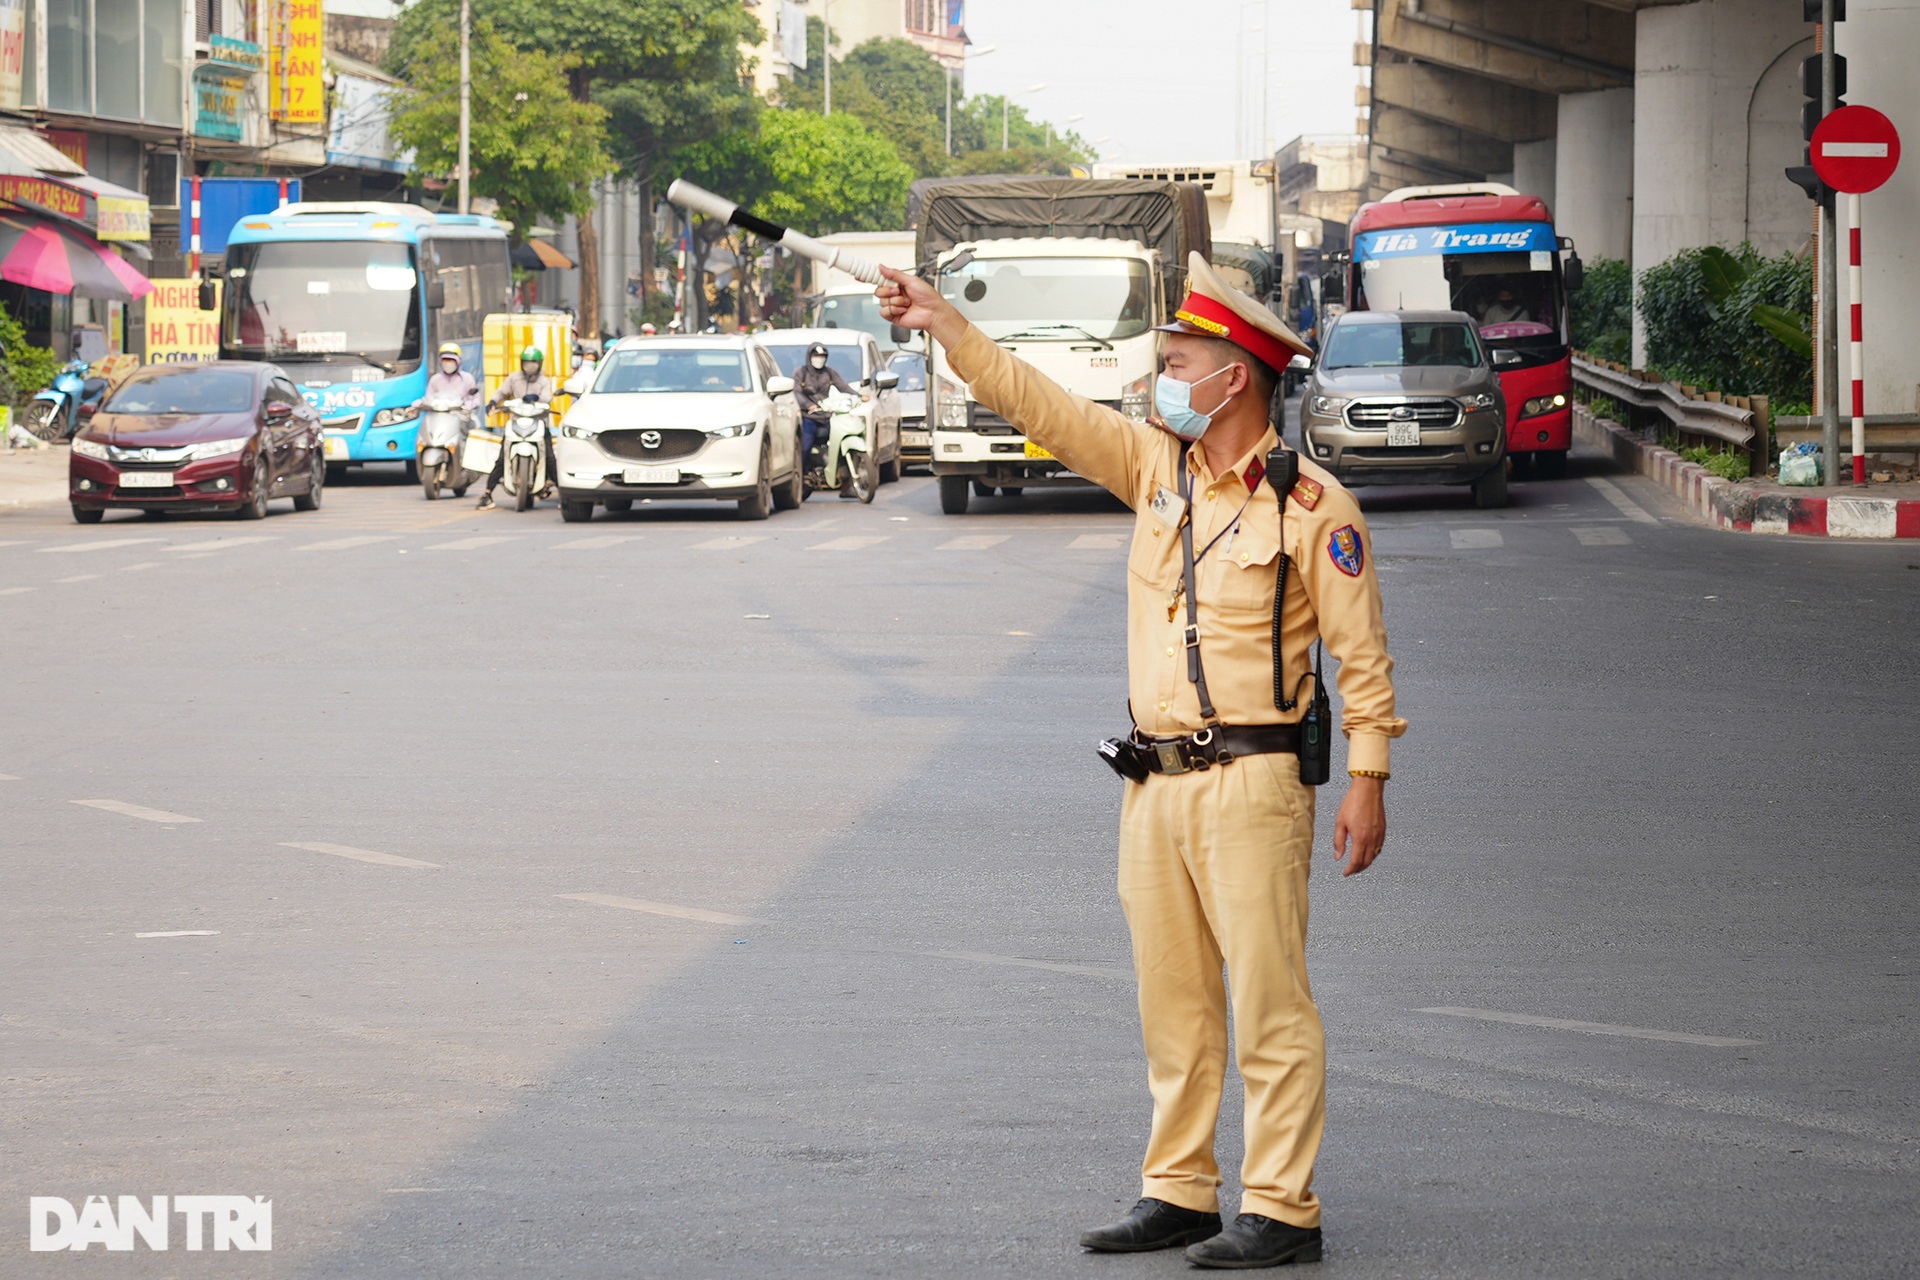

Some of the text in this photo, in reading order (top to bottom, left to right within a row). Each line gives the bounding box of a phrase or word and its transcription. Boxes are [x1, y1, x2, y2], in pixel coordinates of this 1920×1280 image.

[1372, 228, 1533, 253] Hà Trang
[151, 317, 220, 345] HÀ TĨN
[1395, 424, 1411, 435] 99C
